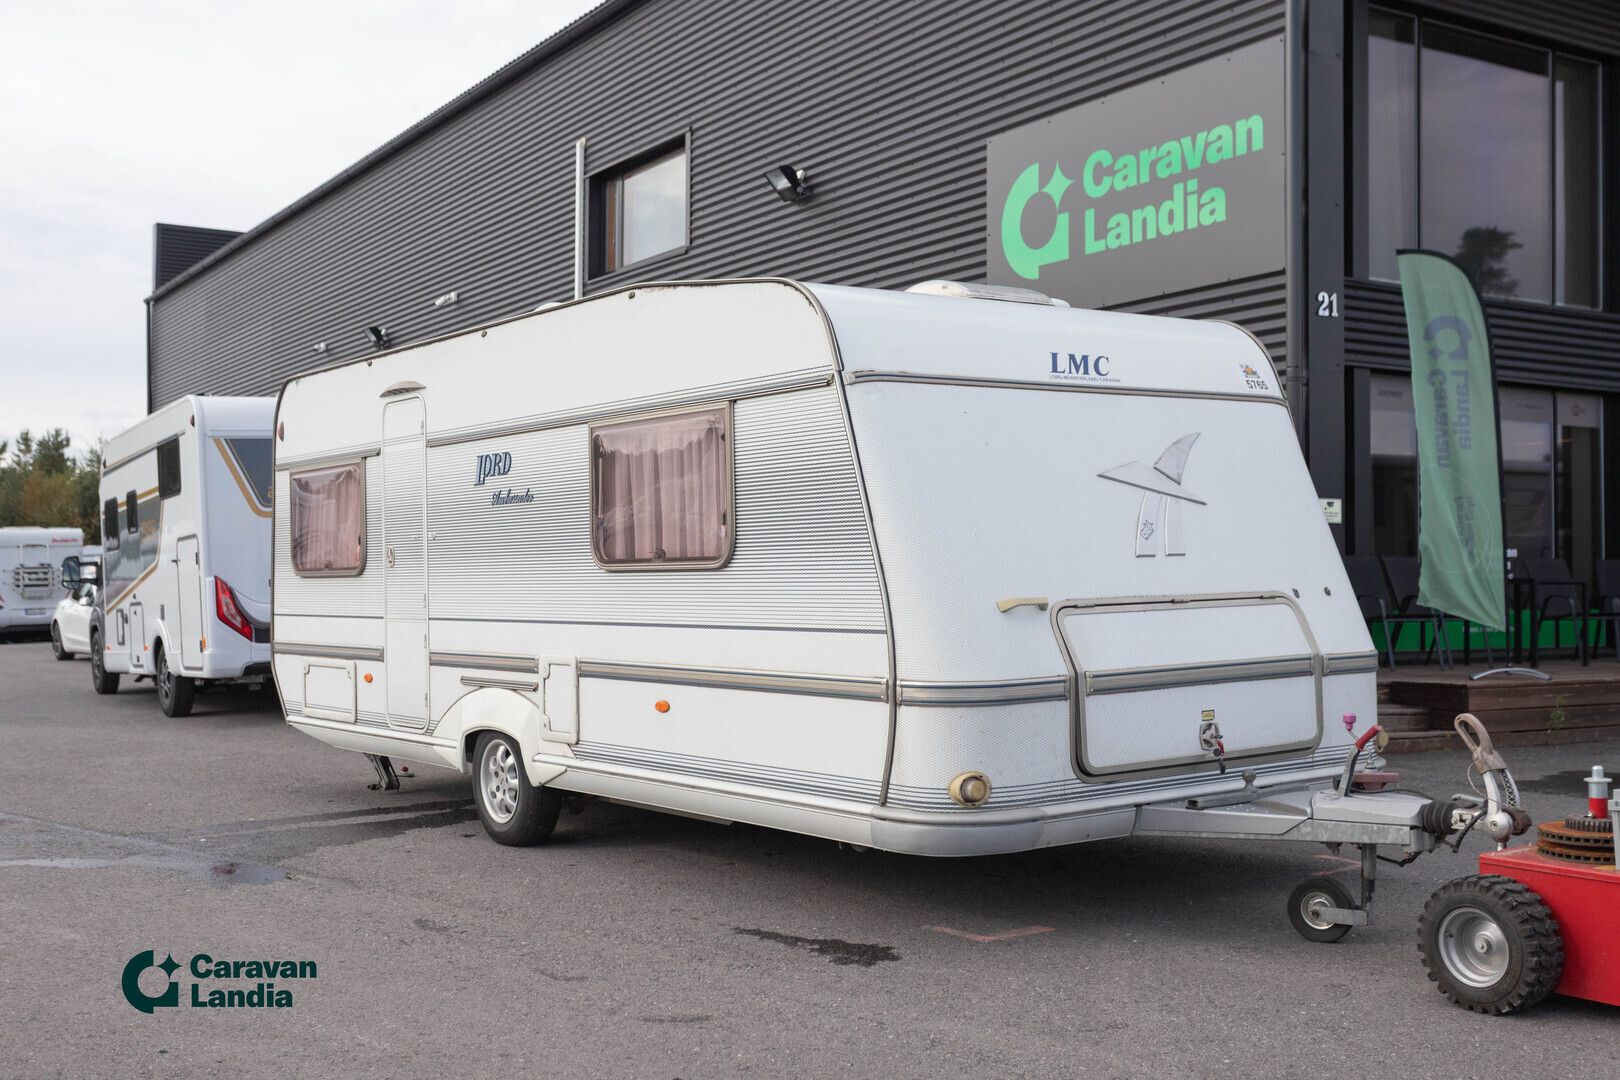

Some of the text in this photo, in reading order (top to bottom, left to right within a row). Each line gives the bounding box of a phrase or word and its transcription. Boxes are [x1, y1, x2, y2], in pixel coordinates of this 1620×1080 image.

[1083, 114, 1264, 198] Caravan
[1085, 178, 1226, 256] Landia
[1317, 291, 1339, 317] 21
[1050, 352, 1110, 377] LMC
